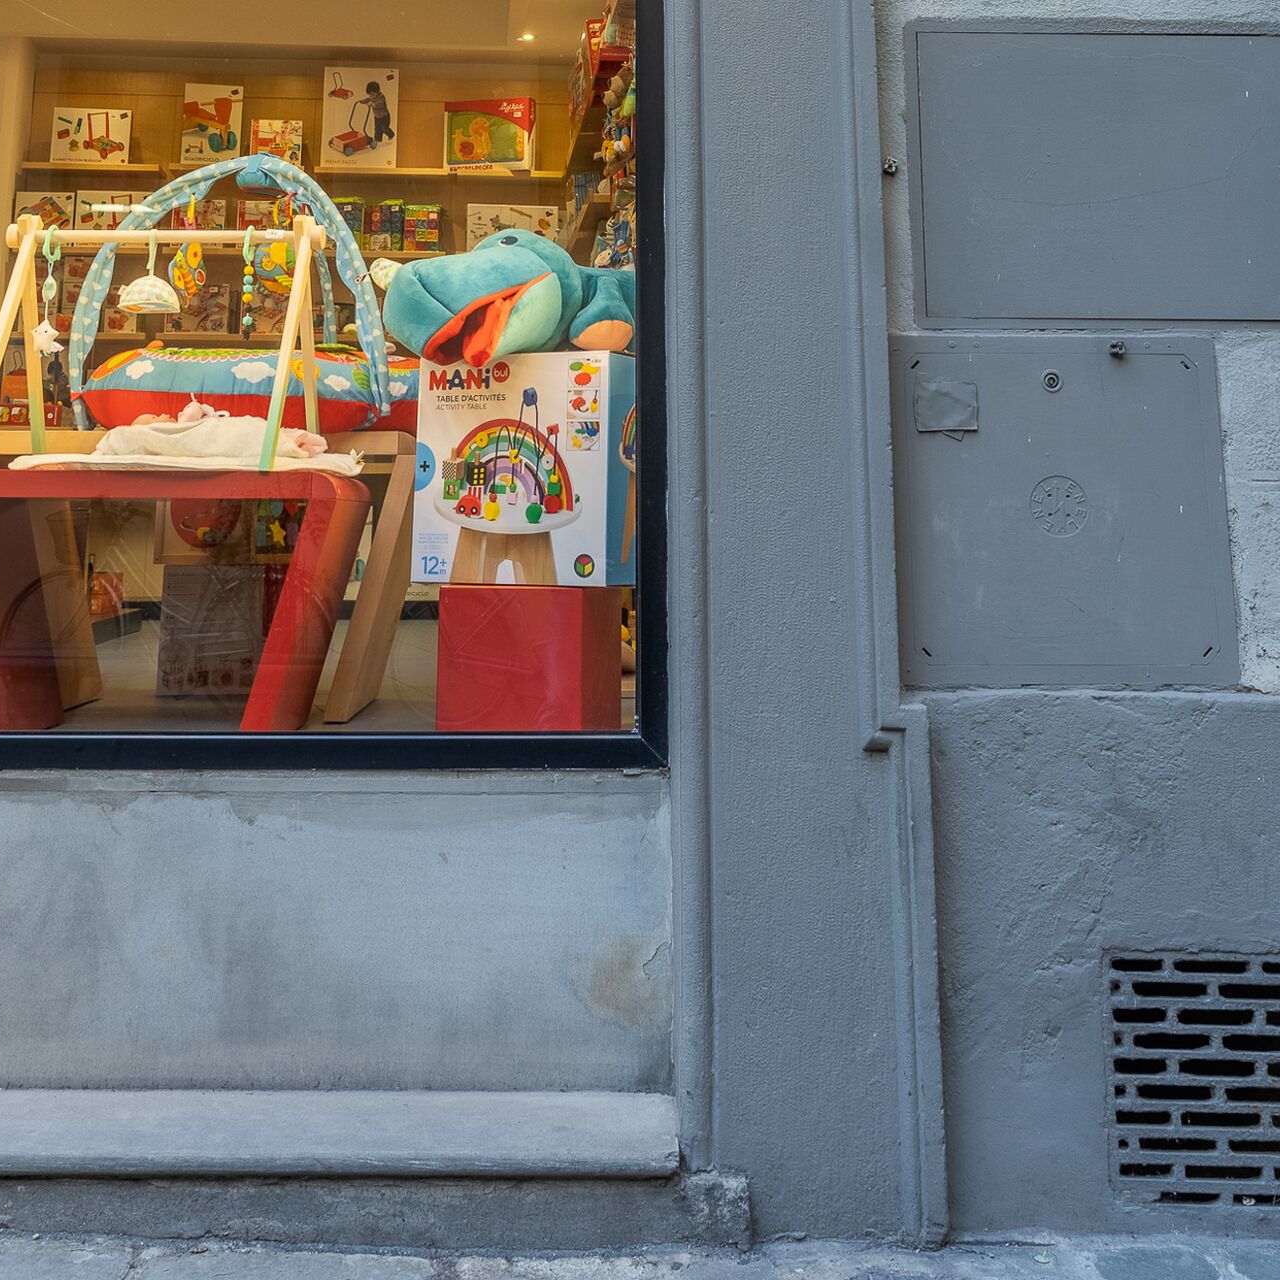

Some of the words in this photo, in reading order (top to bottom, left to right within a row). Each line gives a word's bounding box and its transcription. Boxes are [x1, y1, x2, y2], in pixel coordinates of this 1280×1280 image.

[493, 366, 508, 378] bul
[437, 395, 460, 403] TABLE
[436, 403, 465, 411] ACTIVITY
